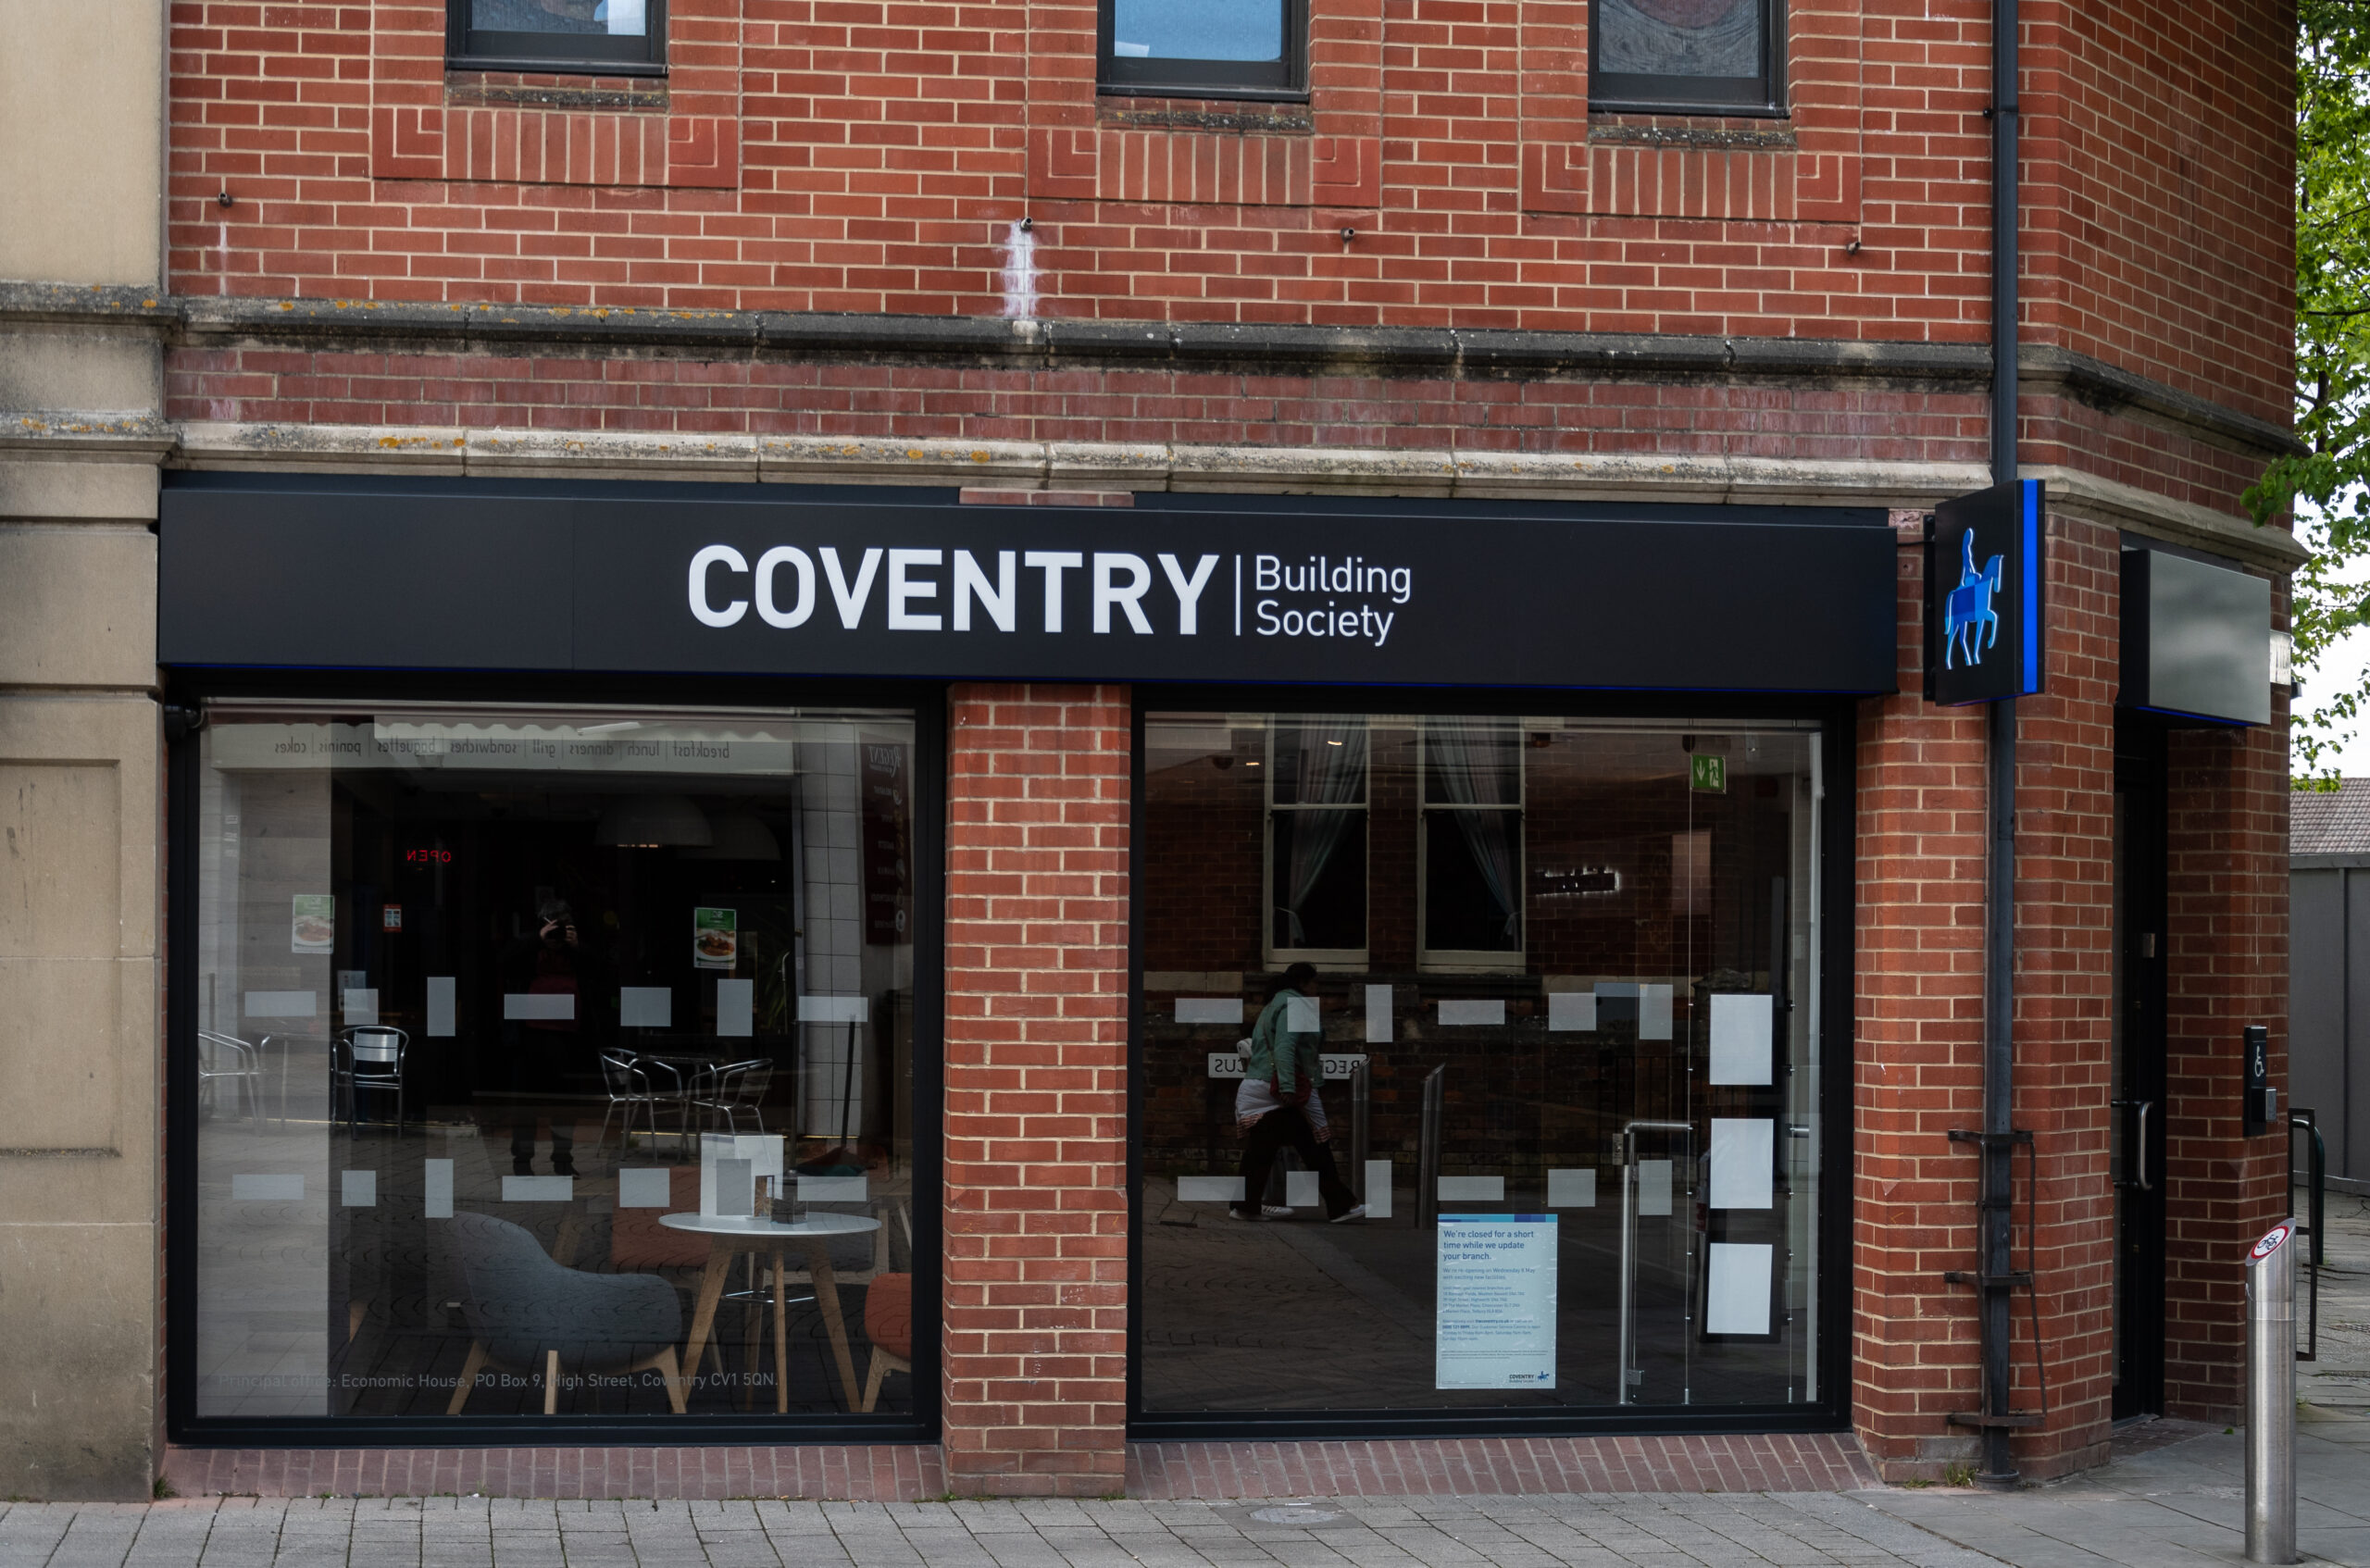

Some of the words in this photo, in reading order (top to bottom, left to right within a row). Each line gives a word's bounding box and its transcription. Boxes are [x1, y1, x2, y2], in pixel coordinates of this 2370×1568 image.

[688, 544, 1220, 636] COVENTRY
[1254, 554, 1412, 604] Building
[1255, 599, 1395, 647] Society
[1443, 1253, 1462, 1262] your
[1498, 1241, 1525, 1251] update
[218, 1375, 286, 1391] Principal
[342, 1375, 414, 1388] Economic
[419, 1375, 470, 1389] House,
[475, 1375, 495, 1387] PO
[501, 1374, 527, 1387] Box
[533, 1374, 545, 1388] 9,
[551, 1374, 583, 1390] High
[588, 1374, 637, 1388] Street,
[642, 1373, 705, 1389] Covntry
[711, 1373, 737, 1387] CV1
[742, 1373, 779, 1387] 5QN.
